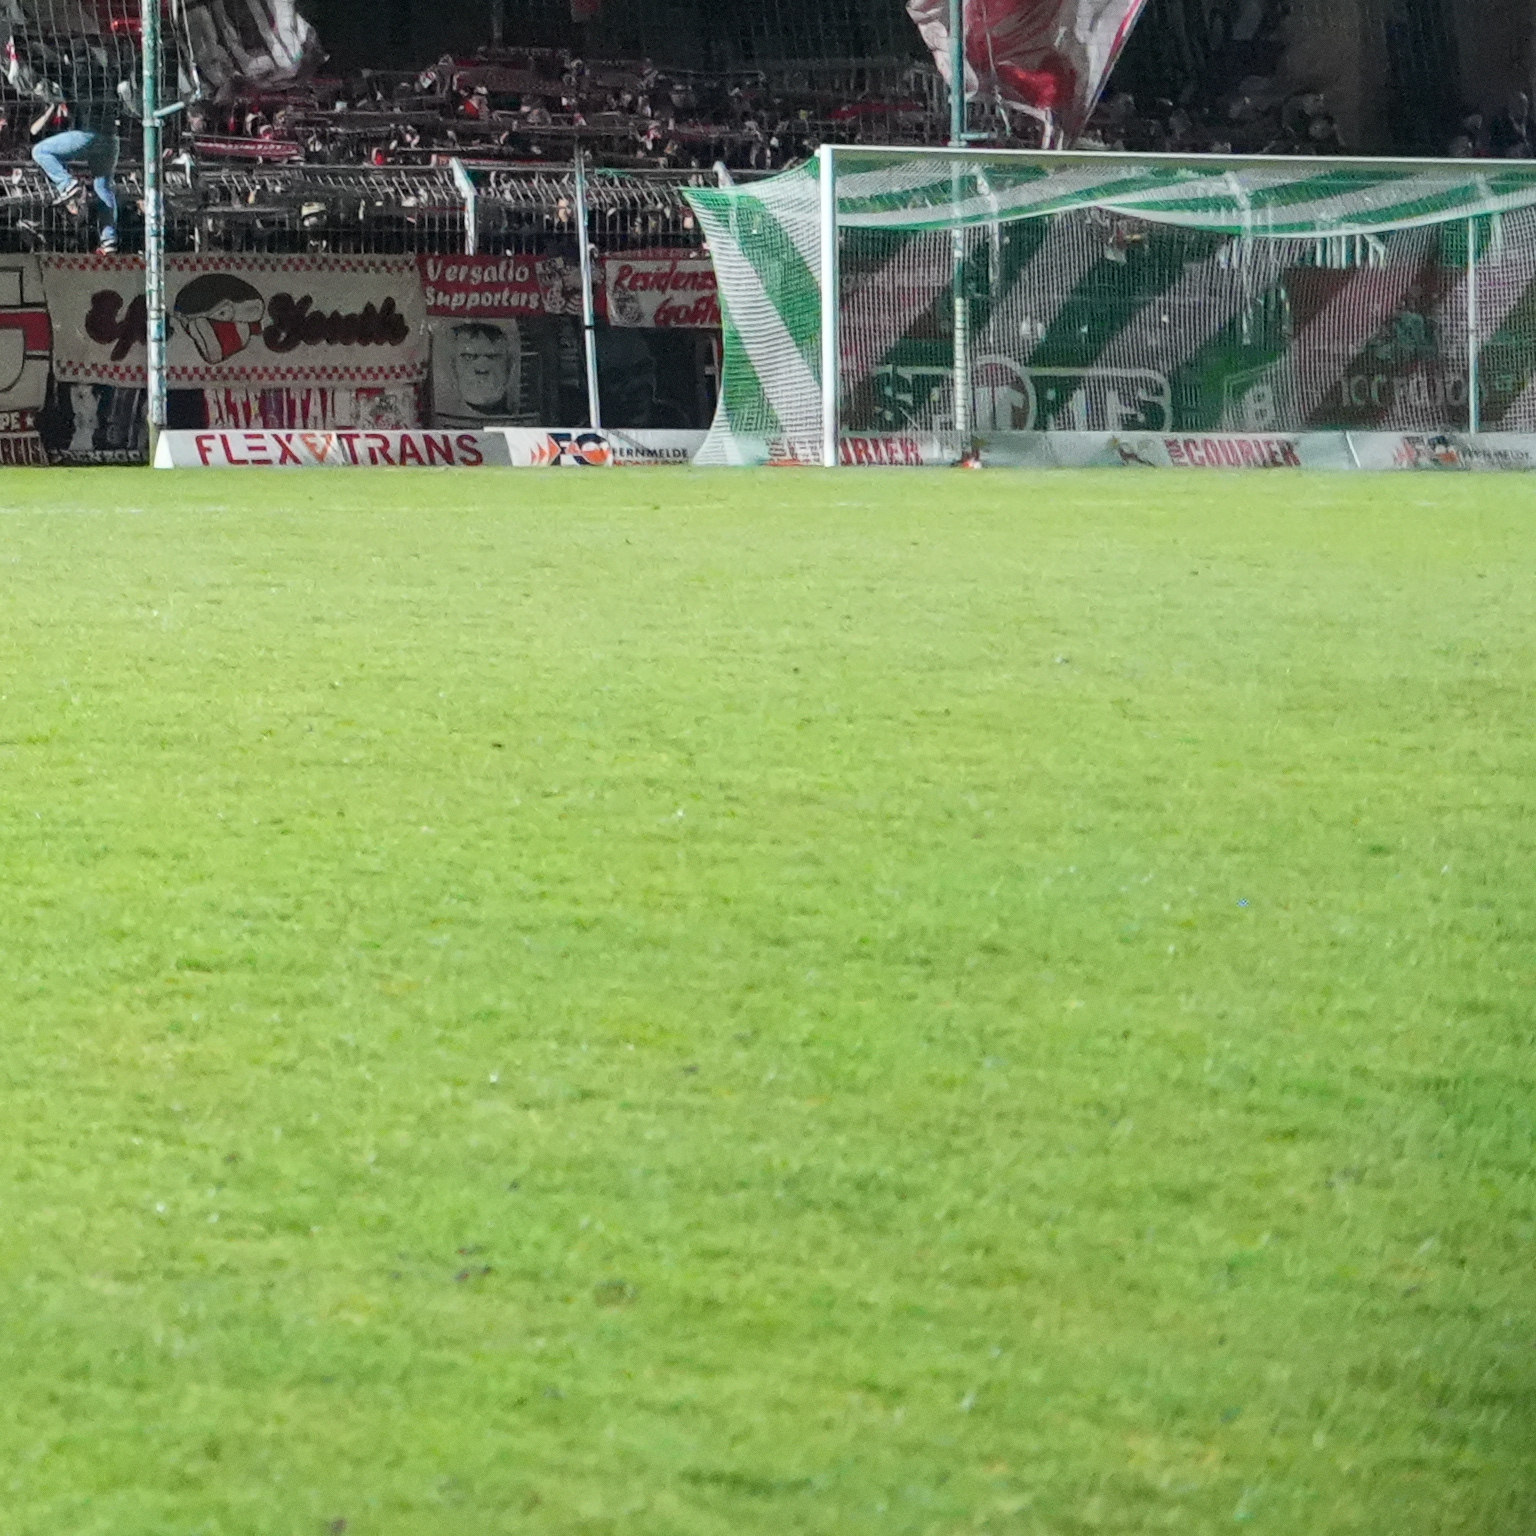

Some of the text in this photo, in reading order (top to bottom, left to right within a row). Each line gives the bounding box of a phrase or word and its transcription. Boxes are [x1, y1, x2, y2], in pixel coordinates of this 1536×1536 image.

[425, 286, 541, 311] Supporters
[195, 434, 483, 467] FLEX TRANS
[612, 447, 688, 459] FERNMELDE
[1182, 438, 1302, 466] COURIER
